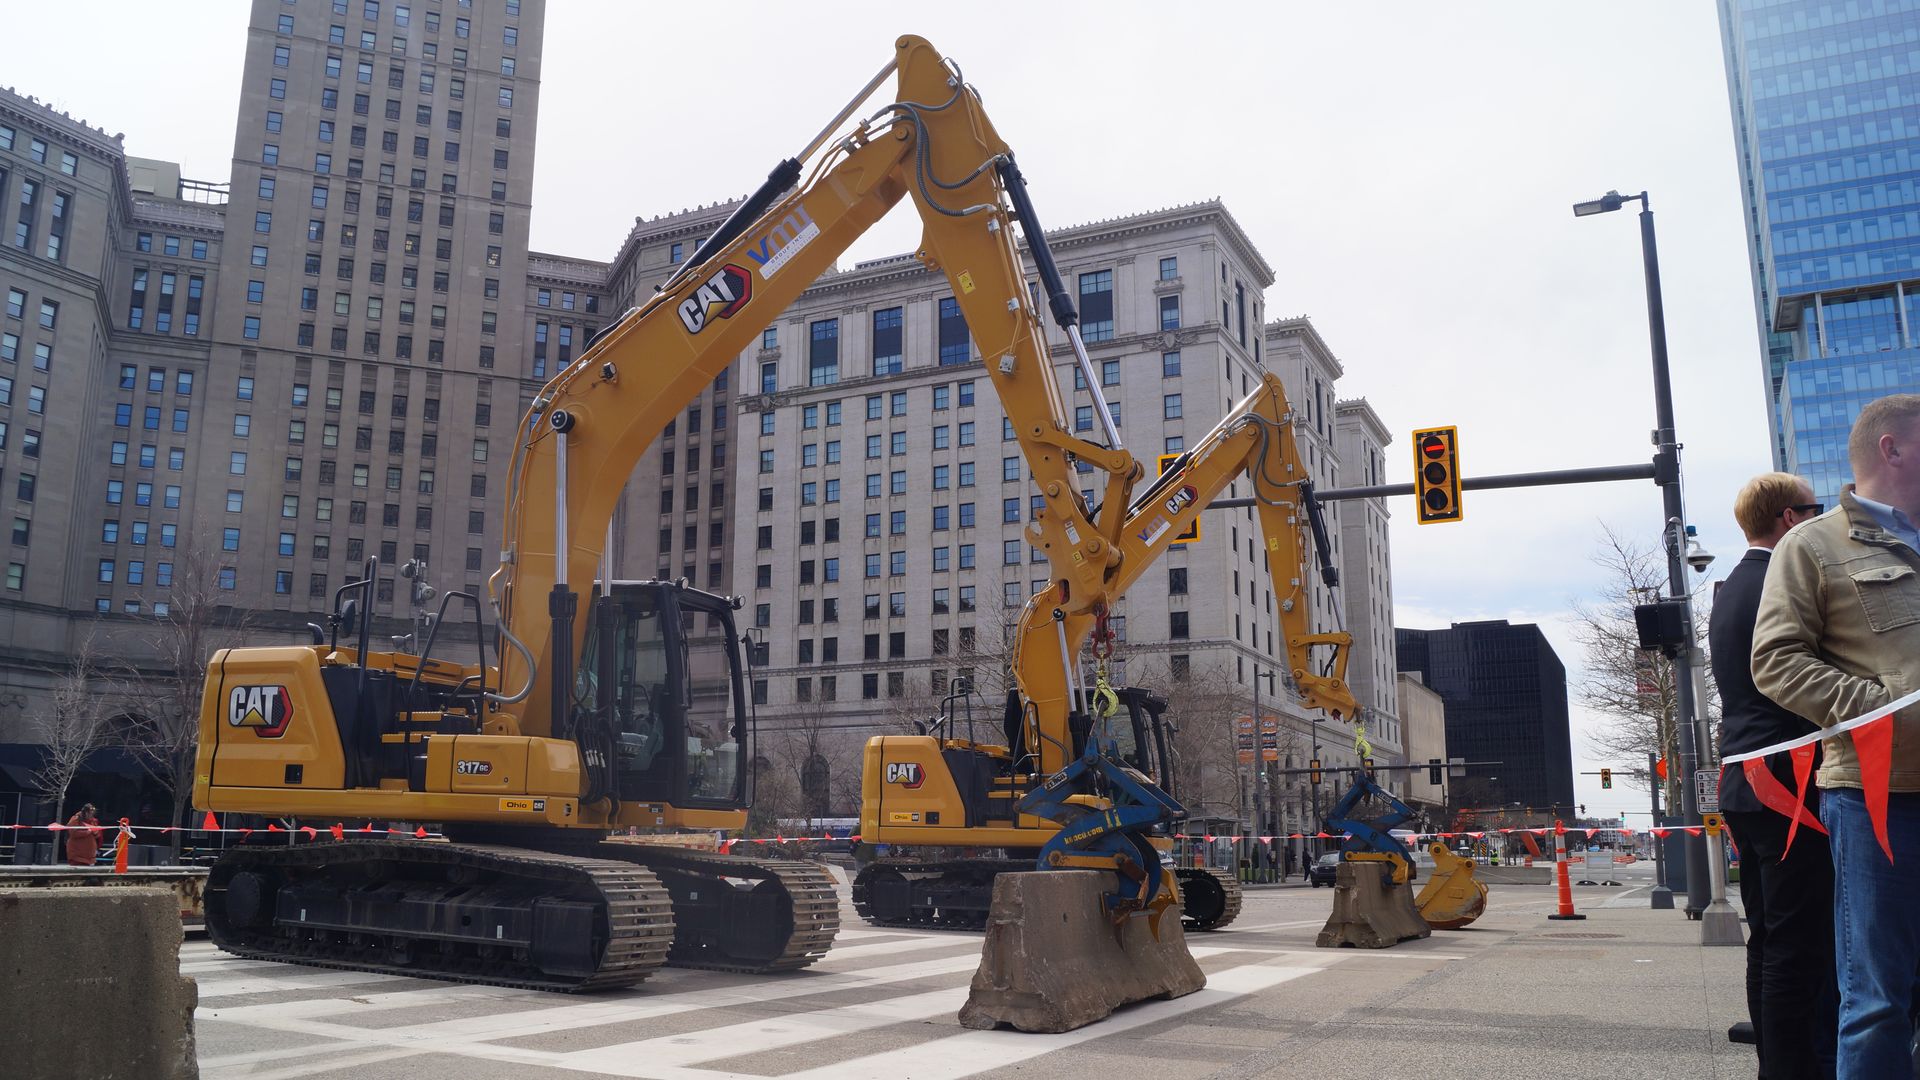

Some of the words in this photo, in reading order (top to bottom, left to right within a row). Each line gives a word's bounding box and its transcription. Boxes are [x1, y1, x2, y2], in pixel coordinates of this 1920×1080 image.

[678, 269, 736, 333] CAT
[1165, 487, 1191, 515] CAT
[229, 686, 279, 726] CAT
[887, 763, 917, 783] CAT
